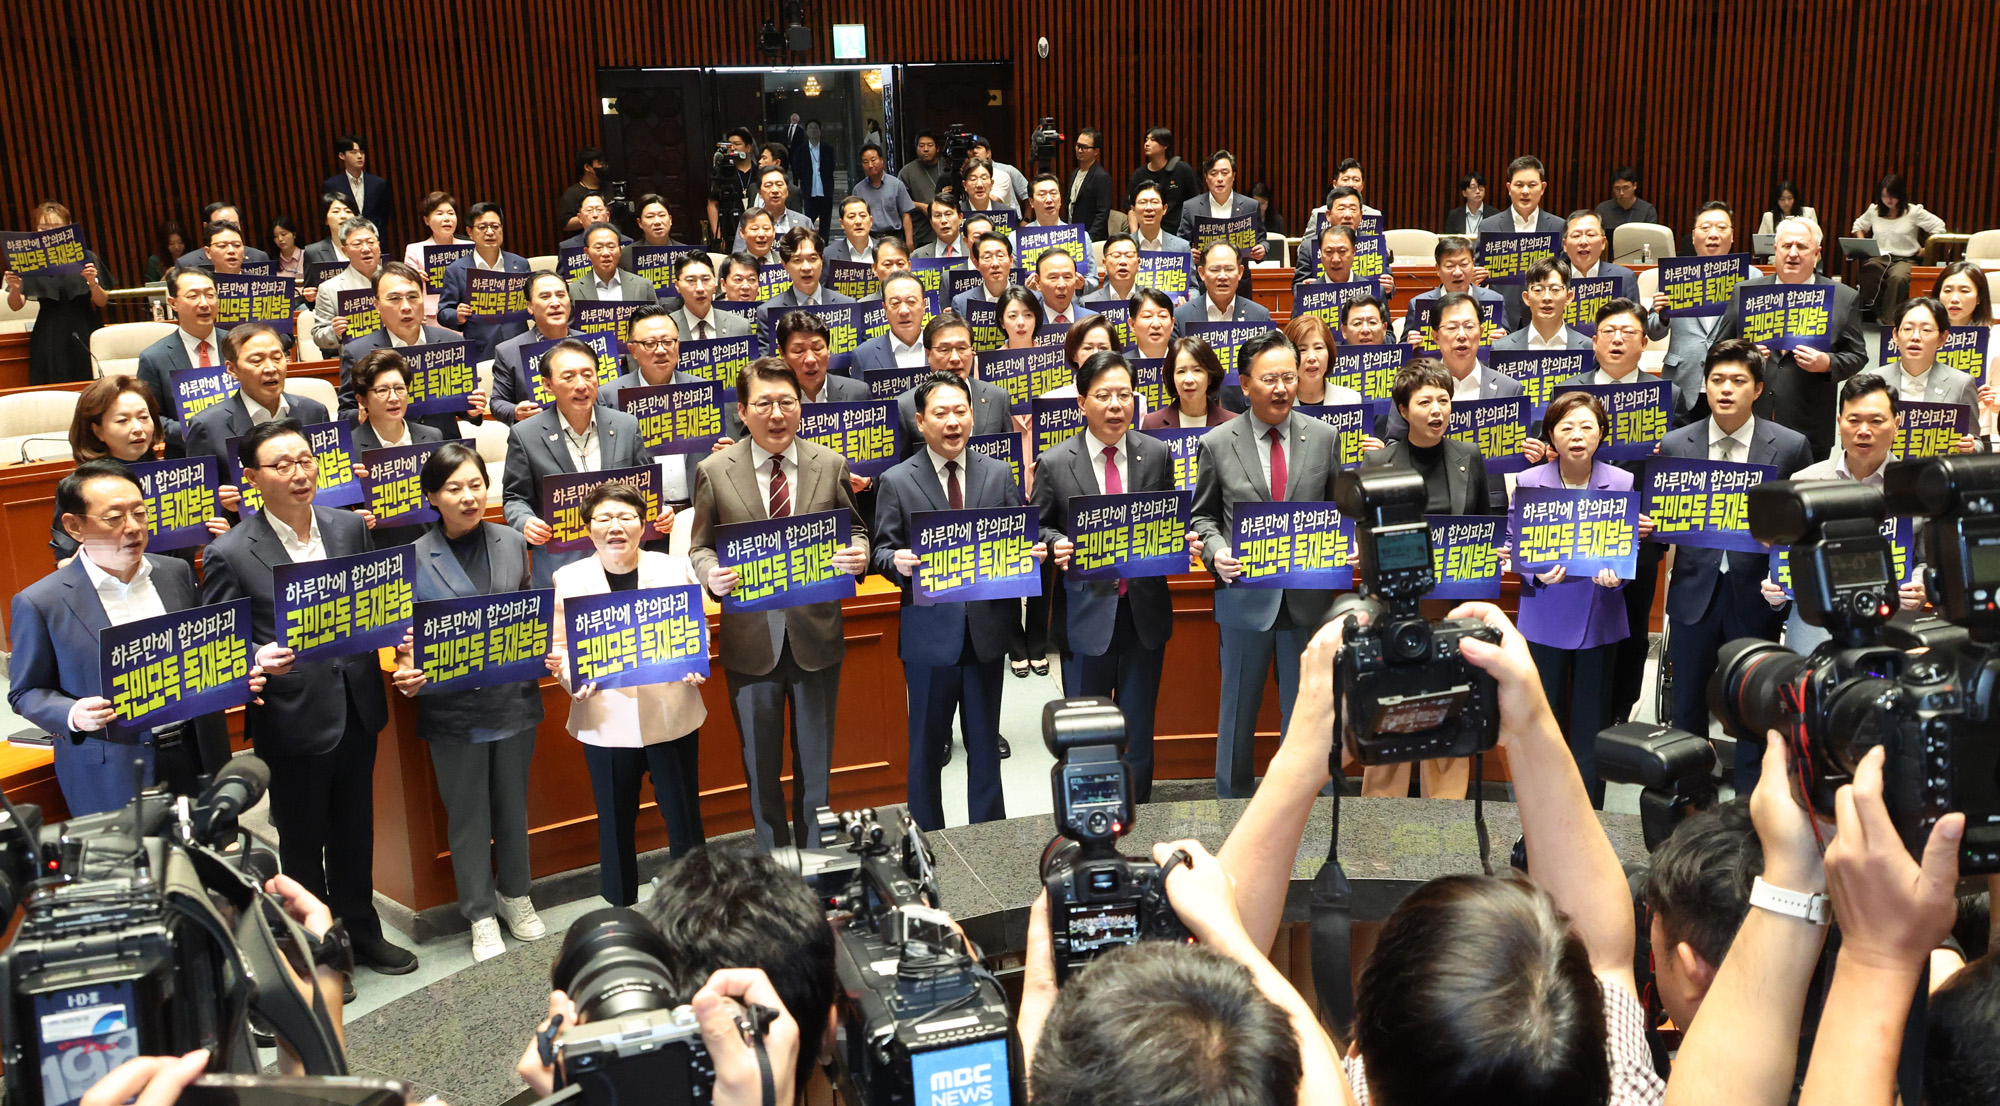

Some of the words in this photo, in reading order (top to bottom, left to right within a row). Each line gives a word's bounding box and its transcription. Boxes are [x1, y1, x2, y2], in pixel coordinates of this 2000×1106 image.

[1021, 233, 1050, 248] 하루만에
[1050, 228, 1077, 243] 합의파괴
[1199, 224, 1225, 234] 하루만에
[1225, 216, 1251, 232] 합의파괴
[7, 238, 39, 254] 하루만에
[42, 228, 74, 247] 합의파괴
[1486, 239, 1517, 254] 하루만에
[1520, 236, 1551, 252] 합의파괴
[10, 250, 47, 272] 국민모독
[48, 242, 84, 266] 독재본능
[429, 251, 461, 267] 하루만에
[638, 253, 667, 267] 하루만에
[1152, 256, 1183, 271] 합의파괴
[1484, 254, 1518, 277] 국민모독
[1665, 265, 1700, 282] 하루만에
[1704, 255, 1739, 278] 합의파괴
[473, 278, 505, 291] 하루만에
[835, 269, 864, 281] 하루만에
[1152, 270, 1187, 291] 독재본능
[216, 281, 248, 296] 루만에
[251, 281, 286, 297] 합의파괴
[1303, 291, 1336, 308] 하루만에
[1578, 281, 1613, 299] 합의파괴
[1665, 281, 1703, 310] 국민모독
[1746, 293, 1784, 312] 하루만에
[1787, 290, 1825, 310] 합의파괴
[216, 298, 250, 322] 민모독
[253, 295, 290, 320] 독재본능
[470, 293, 506, 315] 국민모독
[581, 308, 613, 322] 하루만에
[1744, 313, 1784, 342] 국민모독
[1784, 307, 1828, 335] 독재본능
[678, 348, 709, 368] 루만에
[712, 338, 748, 362] 합의파괴
[1944, 330, 1978, 349] 의파괴
[424, 345, 464, 368] 합의파괴
[986, 357, 1024, 378] 하루만에
[1028, 349, 1064, 371] 합의파괴
[1363, 349, 1402, 370] 합의파괴
[1542, 355, 1584, 376] 합의파괴
[179, 376, 222, 400] 하루만에
[428, 363, 473, 398] 독재본능
[872, 376, 912, 397] 하루만에
[673, 386, 712, 408] 합의파괴
[1614, 387, 1659, 411] 합의파괴
[676, 404, 721, 439] 독재본능
[843, 406, 886, 429] 합의파괴
[1476, 402, 1519, 427] 합의파괴
[1617, 408, 1667, 443] 독재본능
[1910, 409, 1957, 427] 합의파괴
[847, 425, 894, 462] 독재본능
[1479, 422, 1526, 459] 독재본능
[155, 463, 204, 493] 합의파괴
[371, 455, 416, 482] 하루만에
[1654, 471, 1707, 492] 하루만에
[1711, 470, 1762, 491] 합의파괴
[161, 488, 214, 530] 독재본능
[372, 476, 422, 518] 국민모독
[1078, 505, 1126, 530] 하루만에
[1131, 496, 1178, 522] 합의파괴
[1241, 513, 1289, 539] 하루만에
[1293, 509, 1341, 533] 합의파괴
[1523, 501, 1574, 524] 하루만에
[1577, 498, 1627, 521] 합의파괴
[1650, 495, 1706, 532] 국민모독
[727, 532, 783, 563] 하루만에
[785, 515, 836, 547] 합의파괴
[921, 522, 974, 549] 하루만에
[977, 513, 1025, 543] 합의파괴
[1076, 527, 1128, 570] 국민모독
[1133, 517, 1185, 558] 독재본능
[1448, 522, 1495, 547] 합의파괴
[1520, 524, 1574, 562] 국민모독
[1578, 519, 1633, 556] 독재본능
[920, 545, 975, 591] 국민모독
[980, 536, 1033, 579] 독재본능
[1239, 536, 1291, 577] 국민모독
[1295, 530, 1348, 569] 독재본능
[1447, 543, 1499, 581] 독재본능
[286, 571, 346, 605] 하루만에
[349, 552, 402, 588] 합의파괴
[287, 596, 351, 650] 국민모독
[356, 579, 413, 629] 독재본능
[424, 609, 481, 640] 하루만에
[487, 594, 540, 627] 합의파괴
[576, 606, 632, 636] 하루만에
[635, 592, 690, 624] 합의파괴
[112, 632, 172, 670] 하루만에
[176, 607, 235, 649] 합의파괴
[423, 633, 484, 682] 국민모독
[489, 618, 547, 665] 독재본능
[577, 628, 637, 679] 국민모독
[641, 615, 700, 662] 독재본능
[113, 658, 180, 720] 국민모독
[184, 635, 247, 692] 독재본능
[930, 1063, 992, 1092] MBC
[931, 1084, 993, 1106] NEWS
